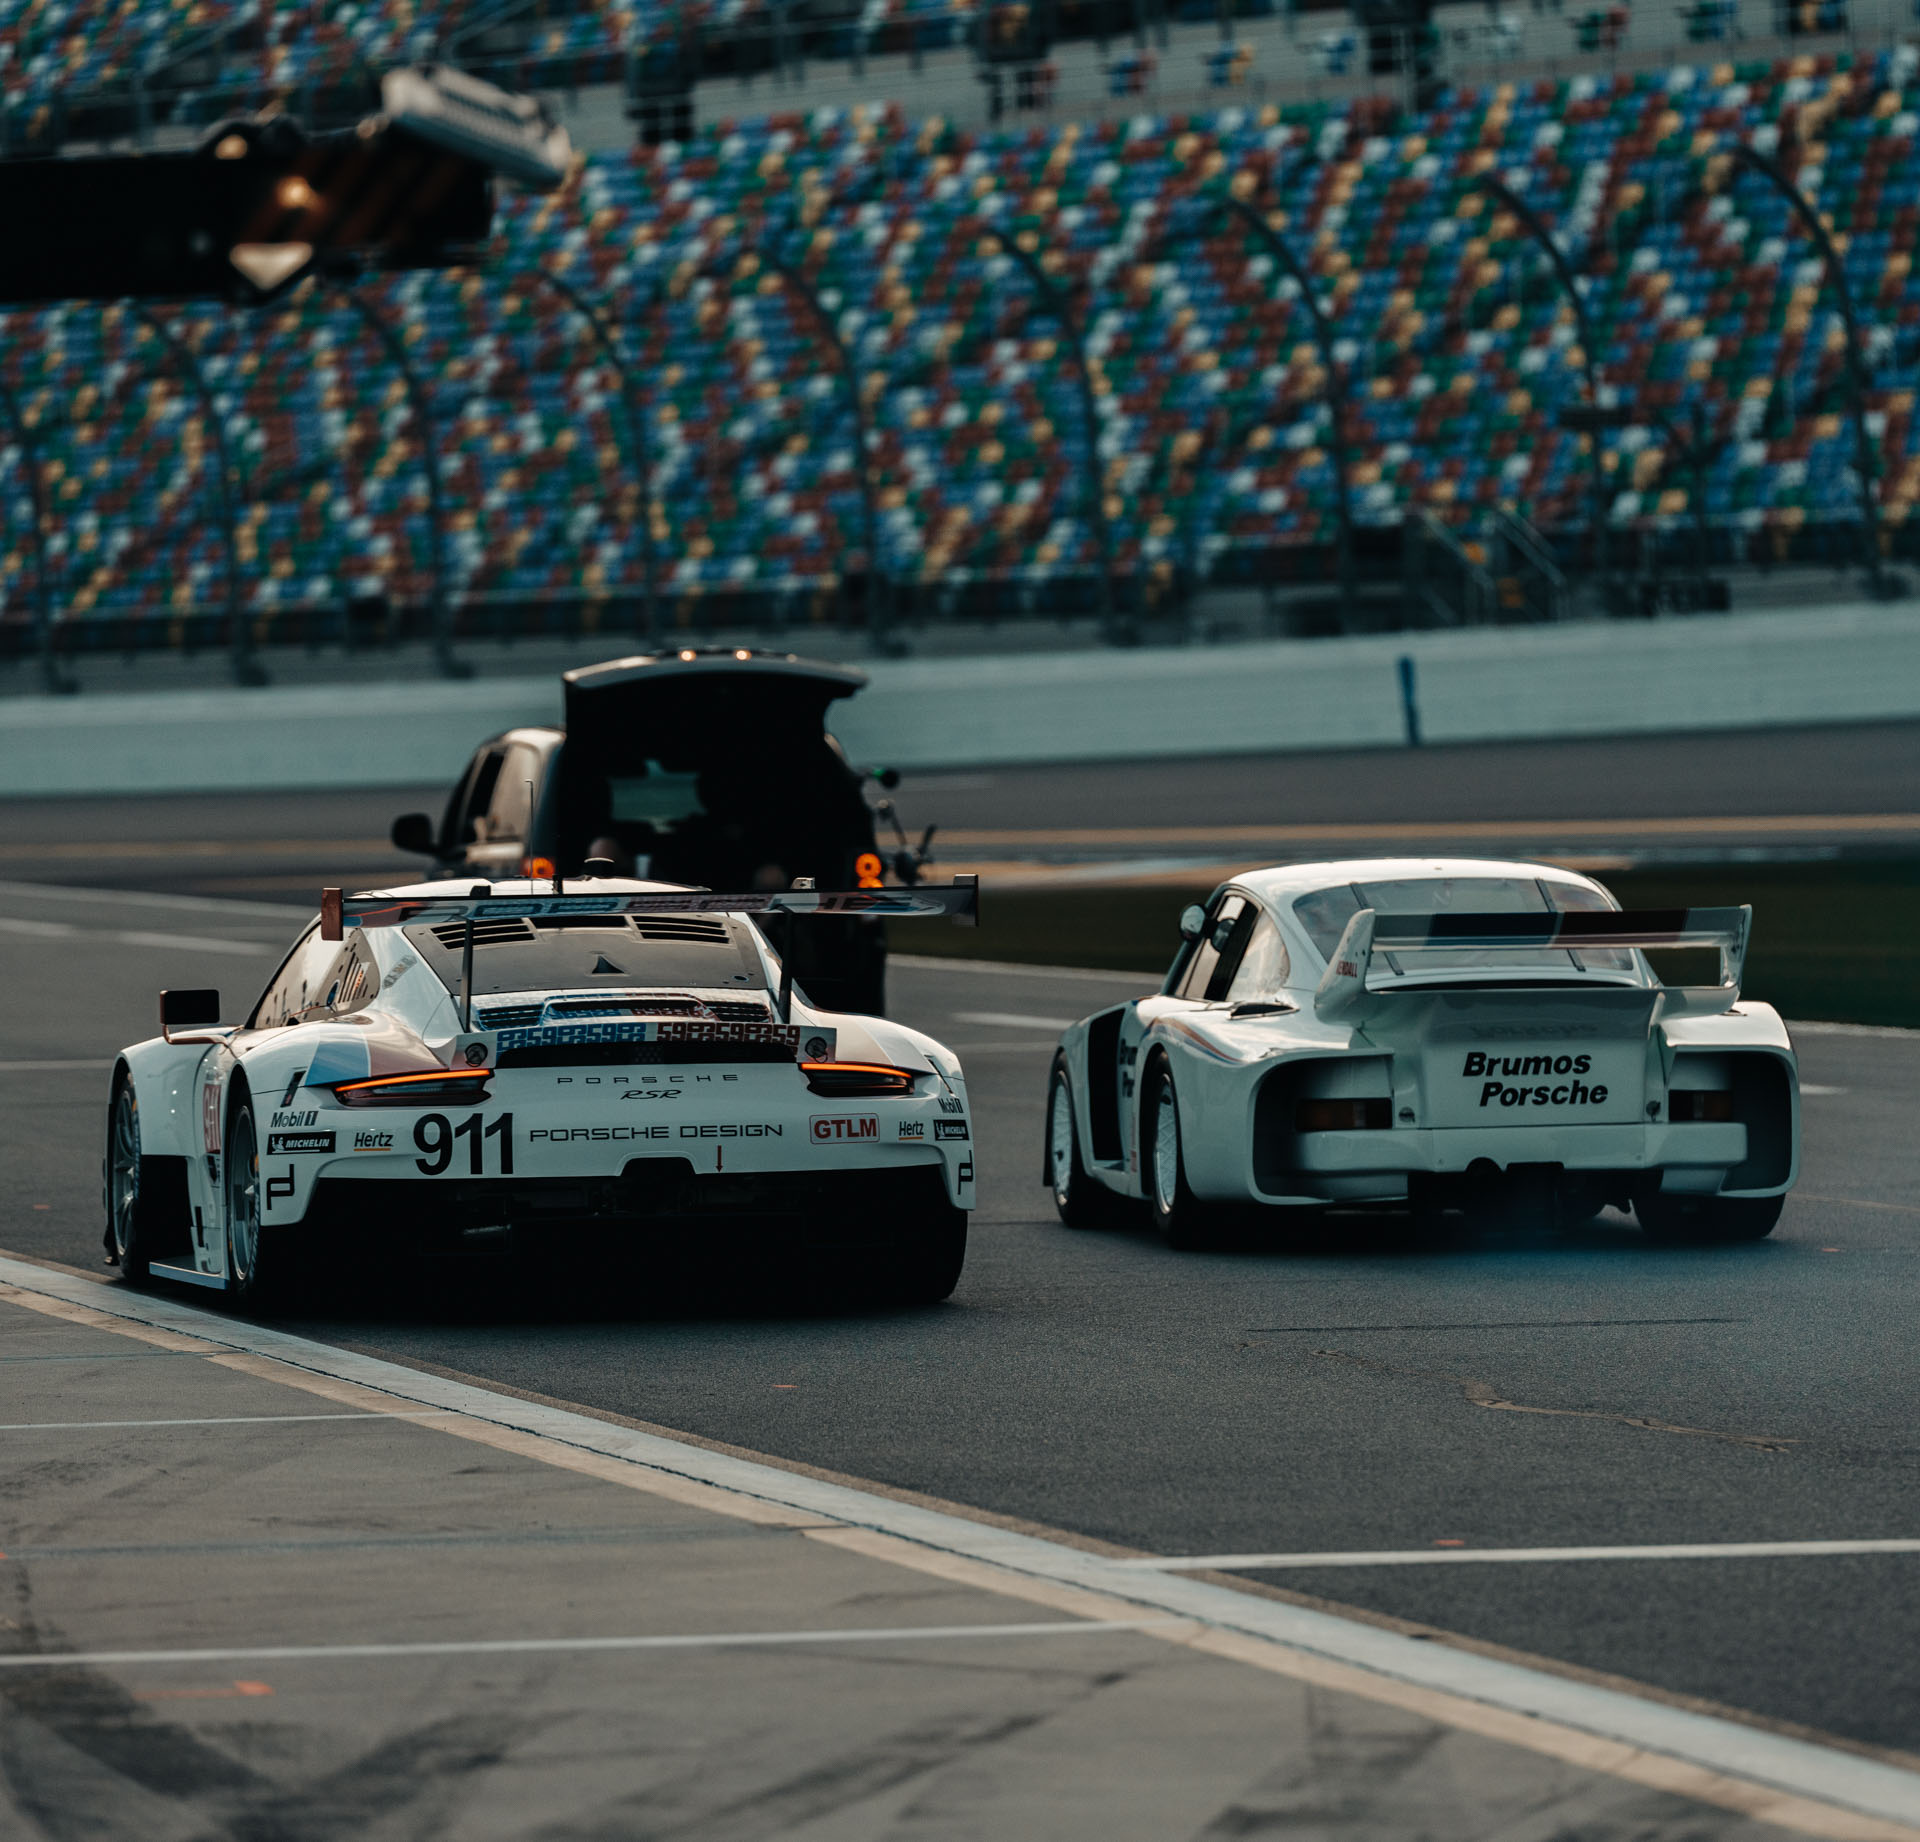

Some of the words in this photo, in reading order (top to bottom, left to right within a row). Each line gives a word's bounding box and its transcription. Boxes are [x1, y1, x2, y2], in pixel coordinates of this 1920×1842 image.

[1463, 1052, 1592, 1077] Brumos
[556, 1074, 738, 1085] PORSCHE
[619, 1089, 682, 1100] RSR
[1479, 1080, 1609, 1107] Porsche
[271, 1111, 305, 1128] Mobil
[304, 1110, 319, 1127] 1
[529, 1126, 670, 1142] PORSCHE
[679, 1124, 783, 1138] DESIGN
[814, 1118, 877, 1139] GTLM
[898, 1121, 924, 1137] Hertz
[285, 1138, 330, 1149] MICHELIN
[354, 1132, 394, 1148] Hertz
[412, 1112, 514, 1175] 911
